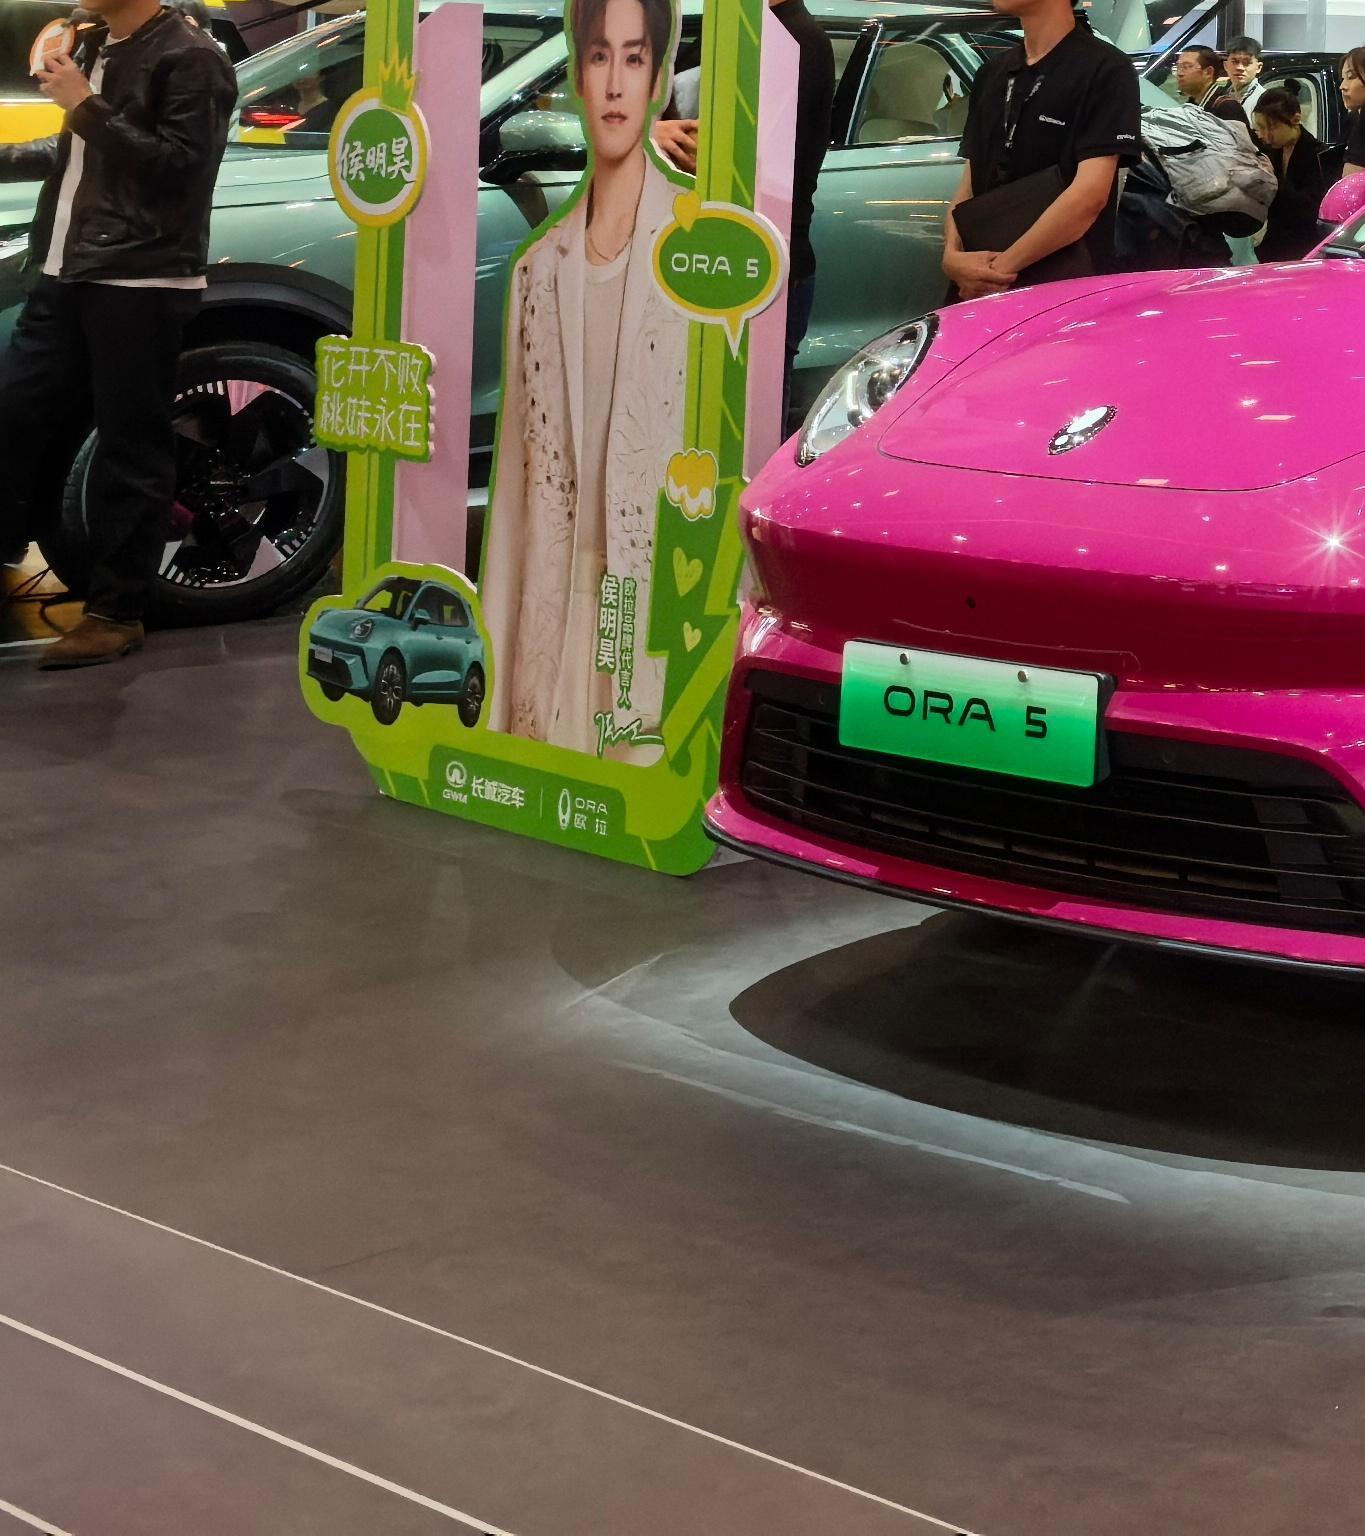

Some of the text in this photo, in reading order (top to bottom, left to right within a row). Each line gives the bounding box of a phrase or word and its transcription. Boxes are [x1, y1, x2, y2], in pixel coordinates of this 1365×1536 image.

[339, 136, 416, 184] 侯明昊
[671, 252, 759, 278] ORA 5
[322, 345, 424, 396] 花开不败
[597, 574, 620, 670] 侯明昊
[883, 684, 1048, 739] ORA 5
[442, 788, 468, 805] GWM
[471, 775, 526, 809] 长城汽车
[574, 796, 608, 816] ORA
